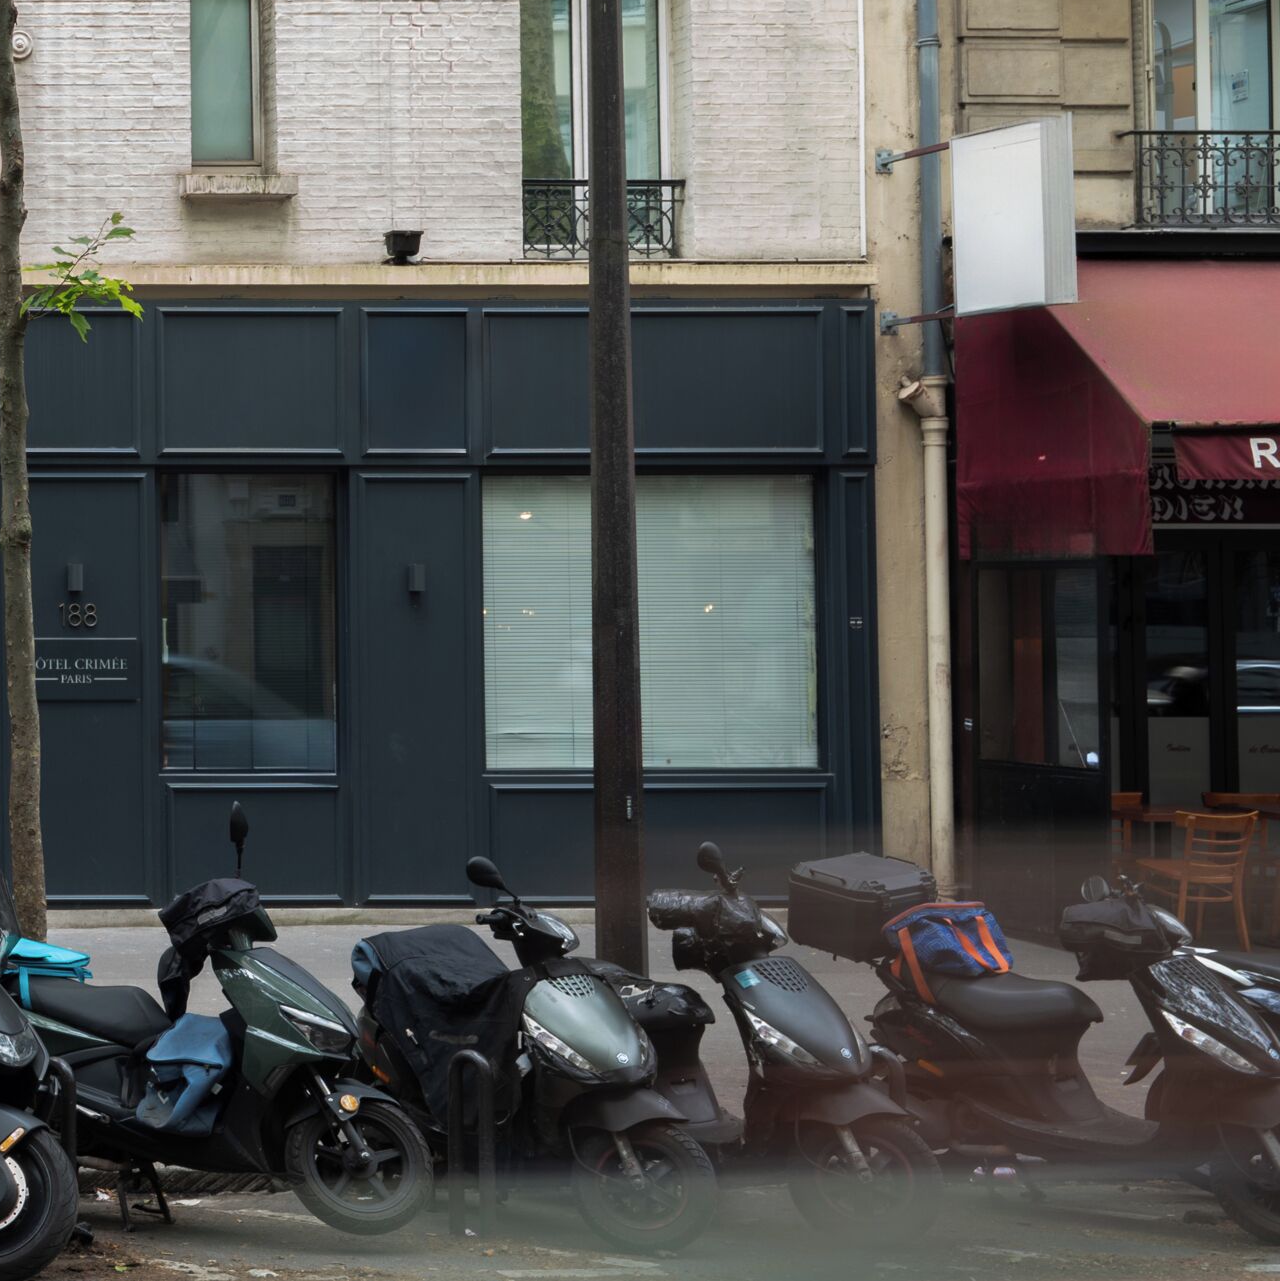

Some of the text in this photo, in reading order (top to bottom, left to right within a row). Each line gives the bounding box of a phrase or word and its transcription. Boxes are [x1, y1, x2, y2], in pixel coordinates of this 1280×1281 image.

[59, 603, 98, 627] 188
[35, 657, 128, 670] ÔTEL CRIMÉE
[60, 674, 92, 684] PARIS
